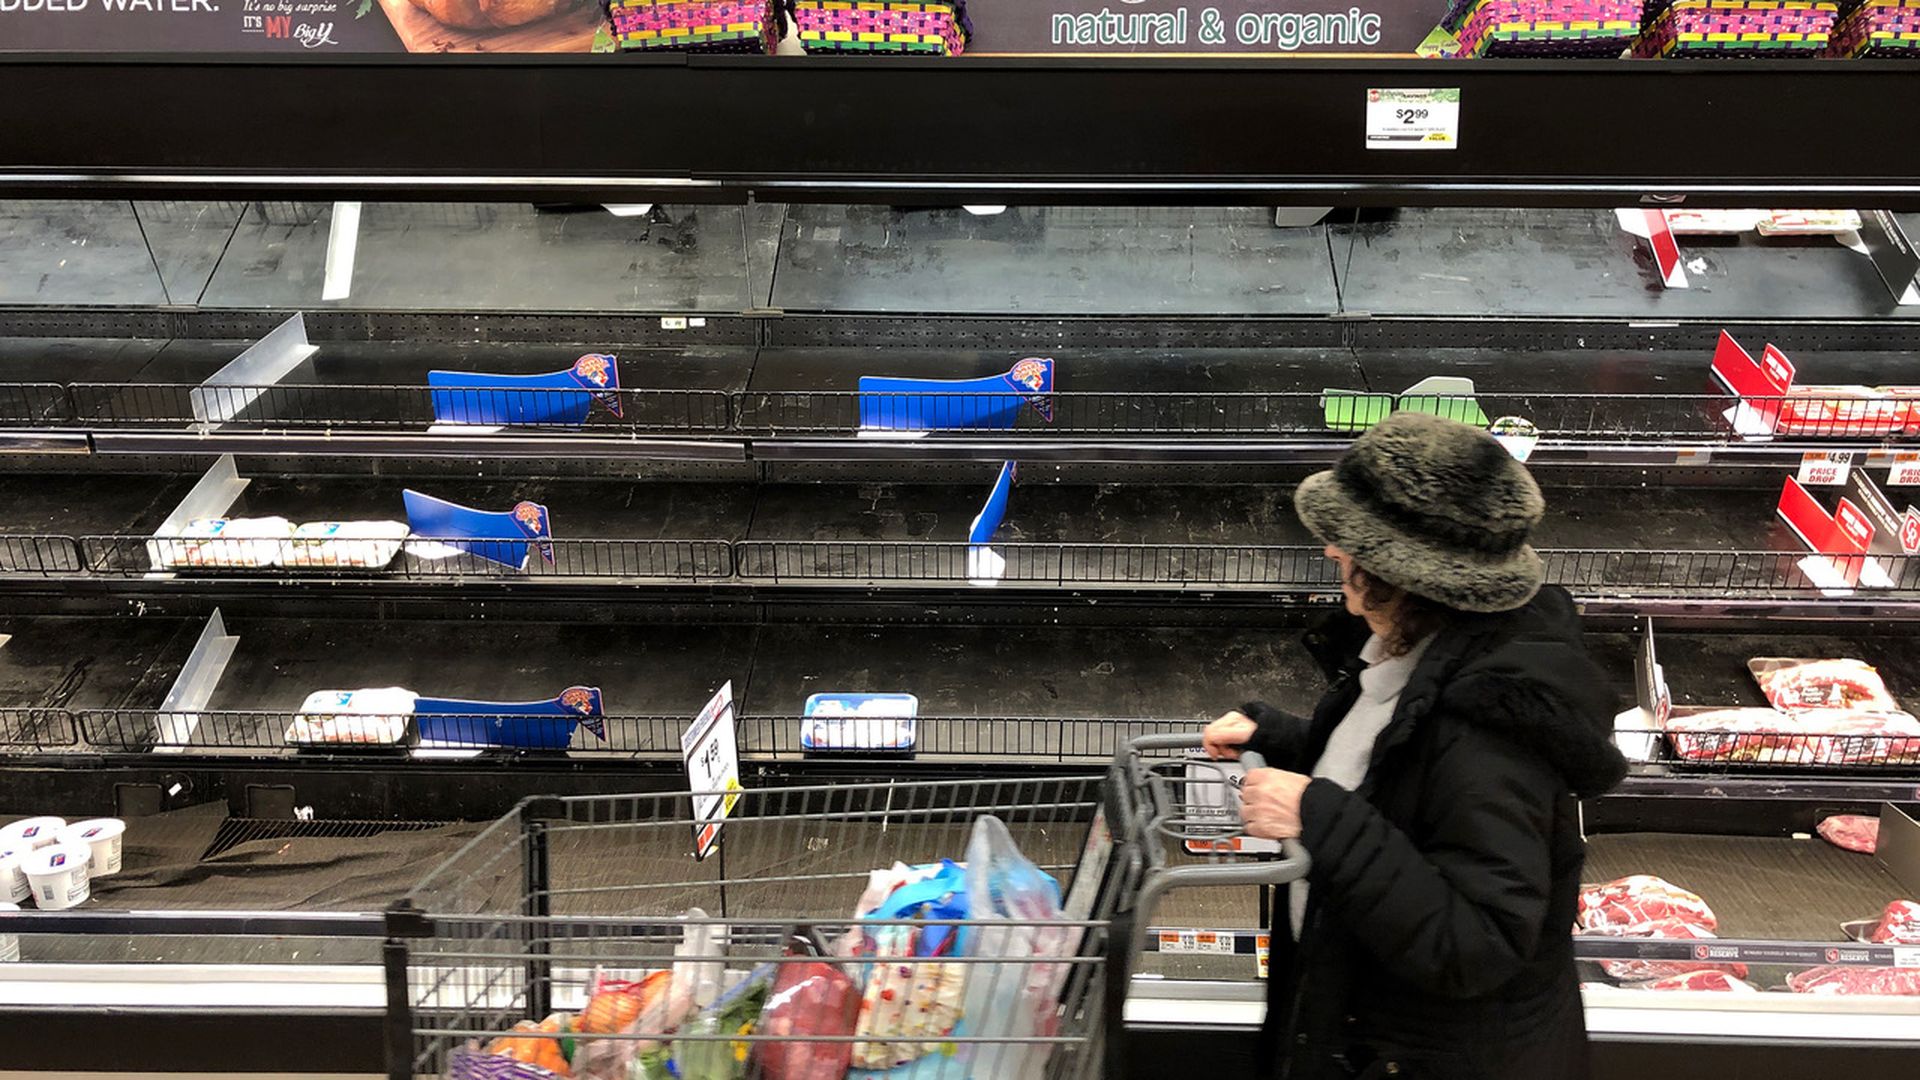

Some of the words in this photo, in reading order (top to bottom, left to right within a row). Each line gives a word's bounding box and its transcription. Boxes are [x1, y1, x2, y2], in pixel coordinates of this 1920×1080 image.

[102, 0, 220, 12] WATER.
[262, 3, 276, 12] no
[277, 0, 293, 15] big
[294, 1, 337, 15] surprise
[265, 15, 292, 39] MY
[1051, 8, 1188, 45] natural
[1198, 8, 1226, 45] &
[1235, 8, 1381, 51] organic
[1809, 467, 1838, 475] PRICE
[1808, 475, 1836, 483] DROP
